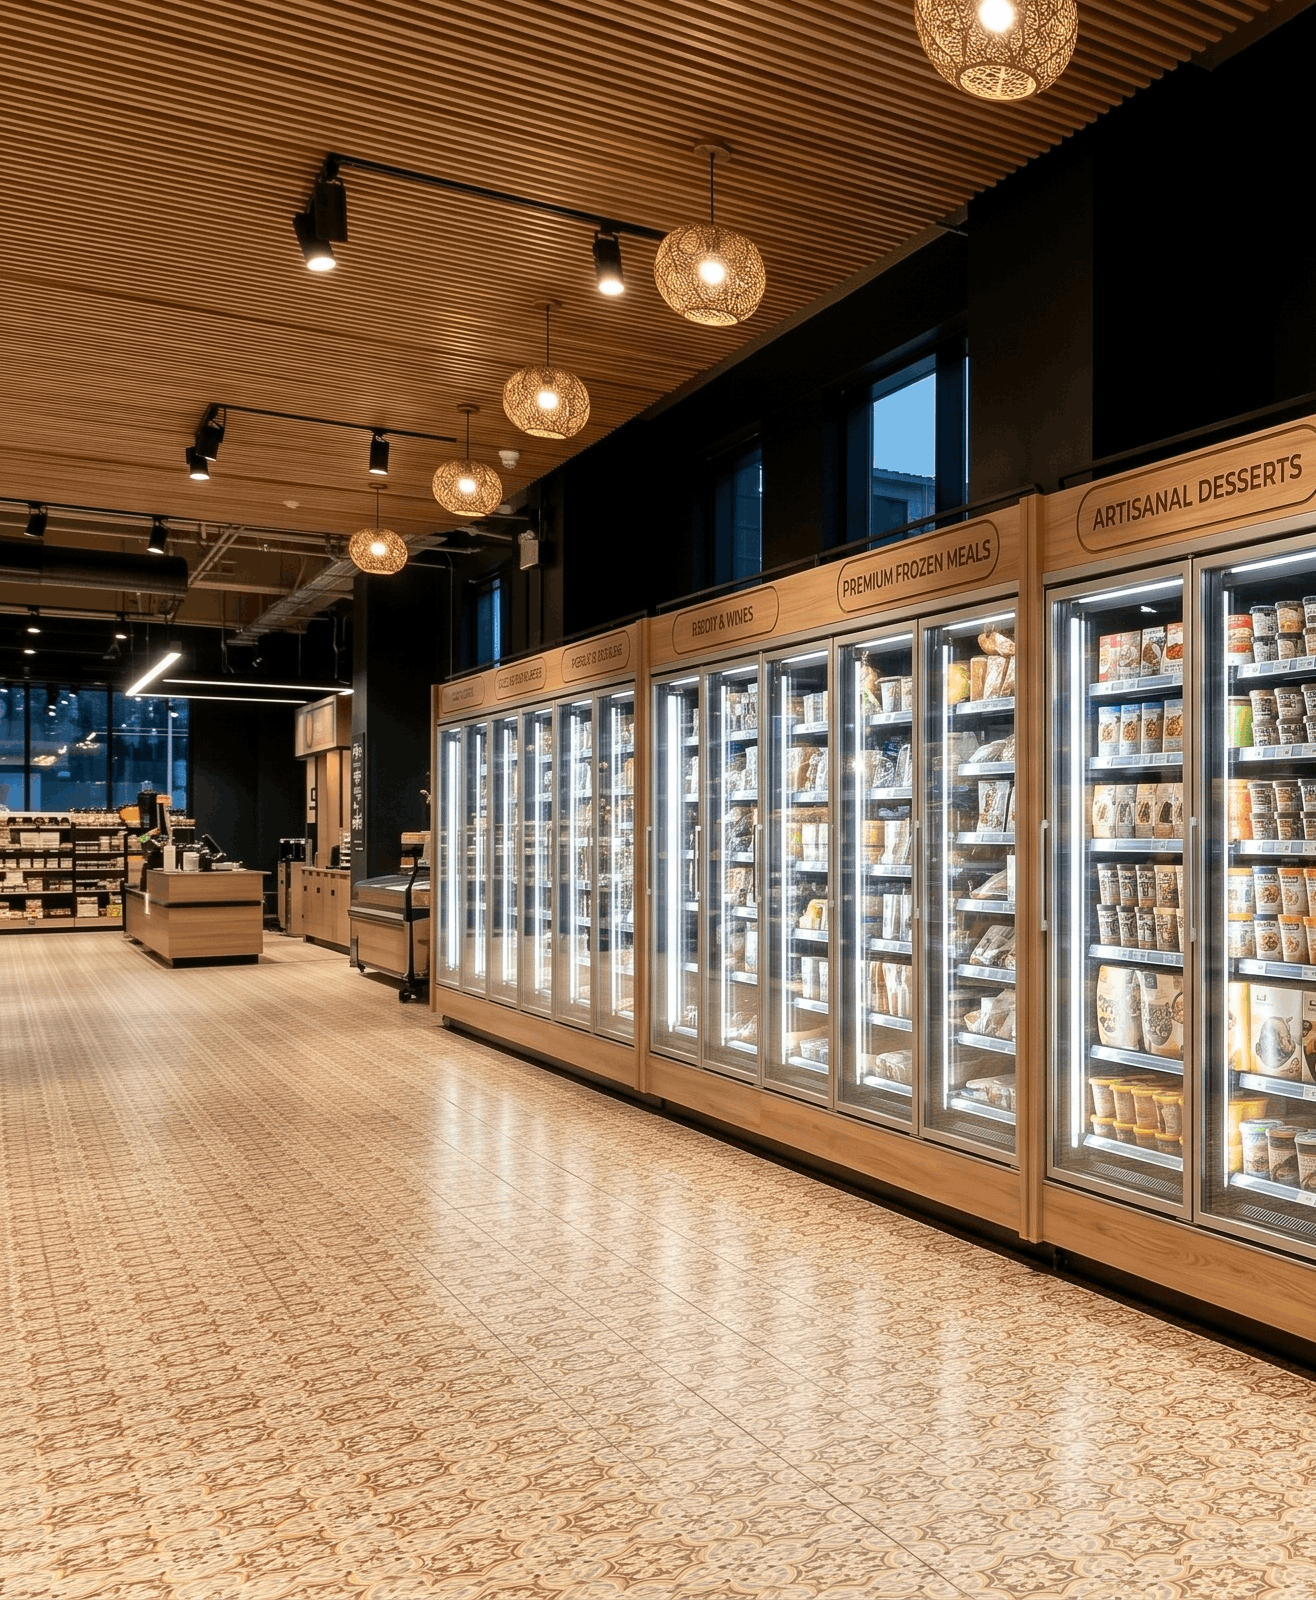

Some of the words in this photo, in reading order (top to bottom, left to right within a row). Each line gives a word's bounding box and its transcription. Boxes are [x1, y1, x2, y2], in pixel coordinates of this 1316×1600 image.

[1092, 484, 1193, 531] ARTISANAL
[1198, 453, 1304, 505] DESSERTS
[842, 563, 894, 599] PREMIUM
[895, 551, 944, 584] FROZEN
[946, 538, 991, 570] MEALS
